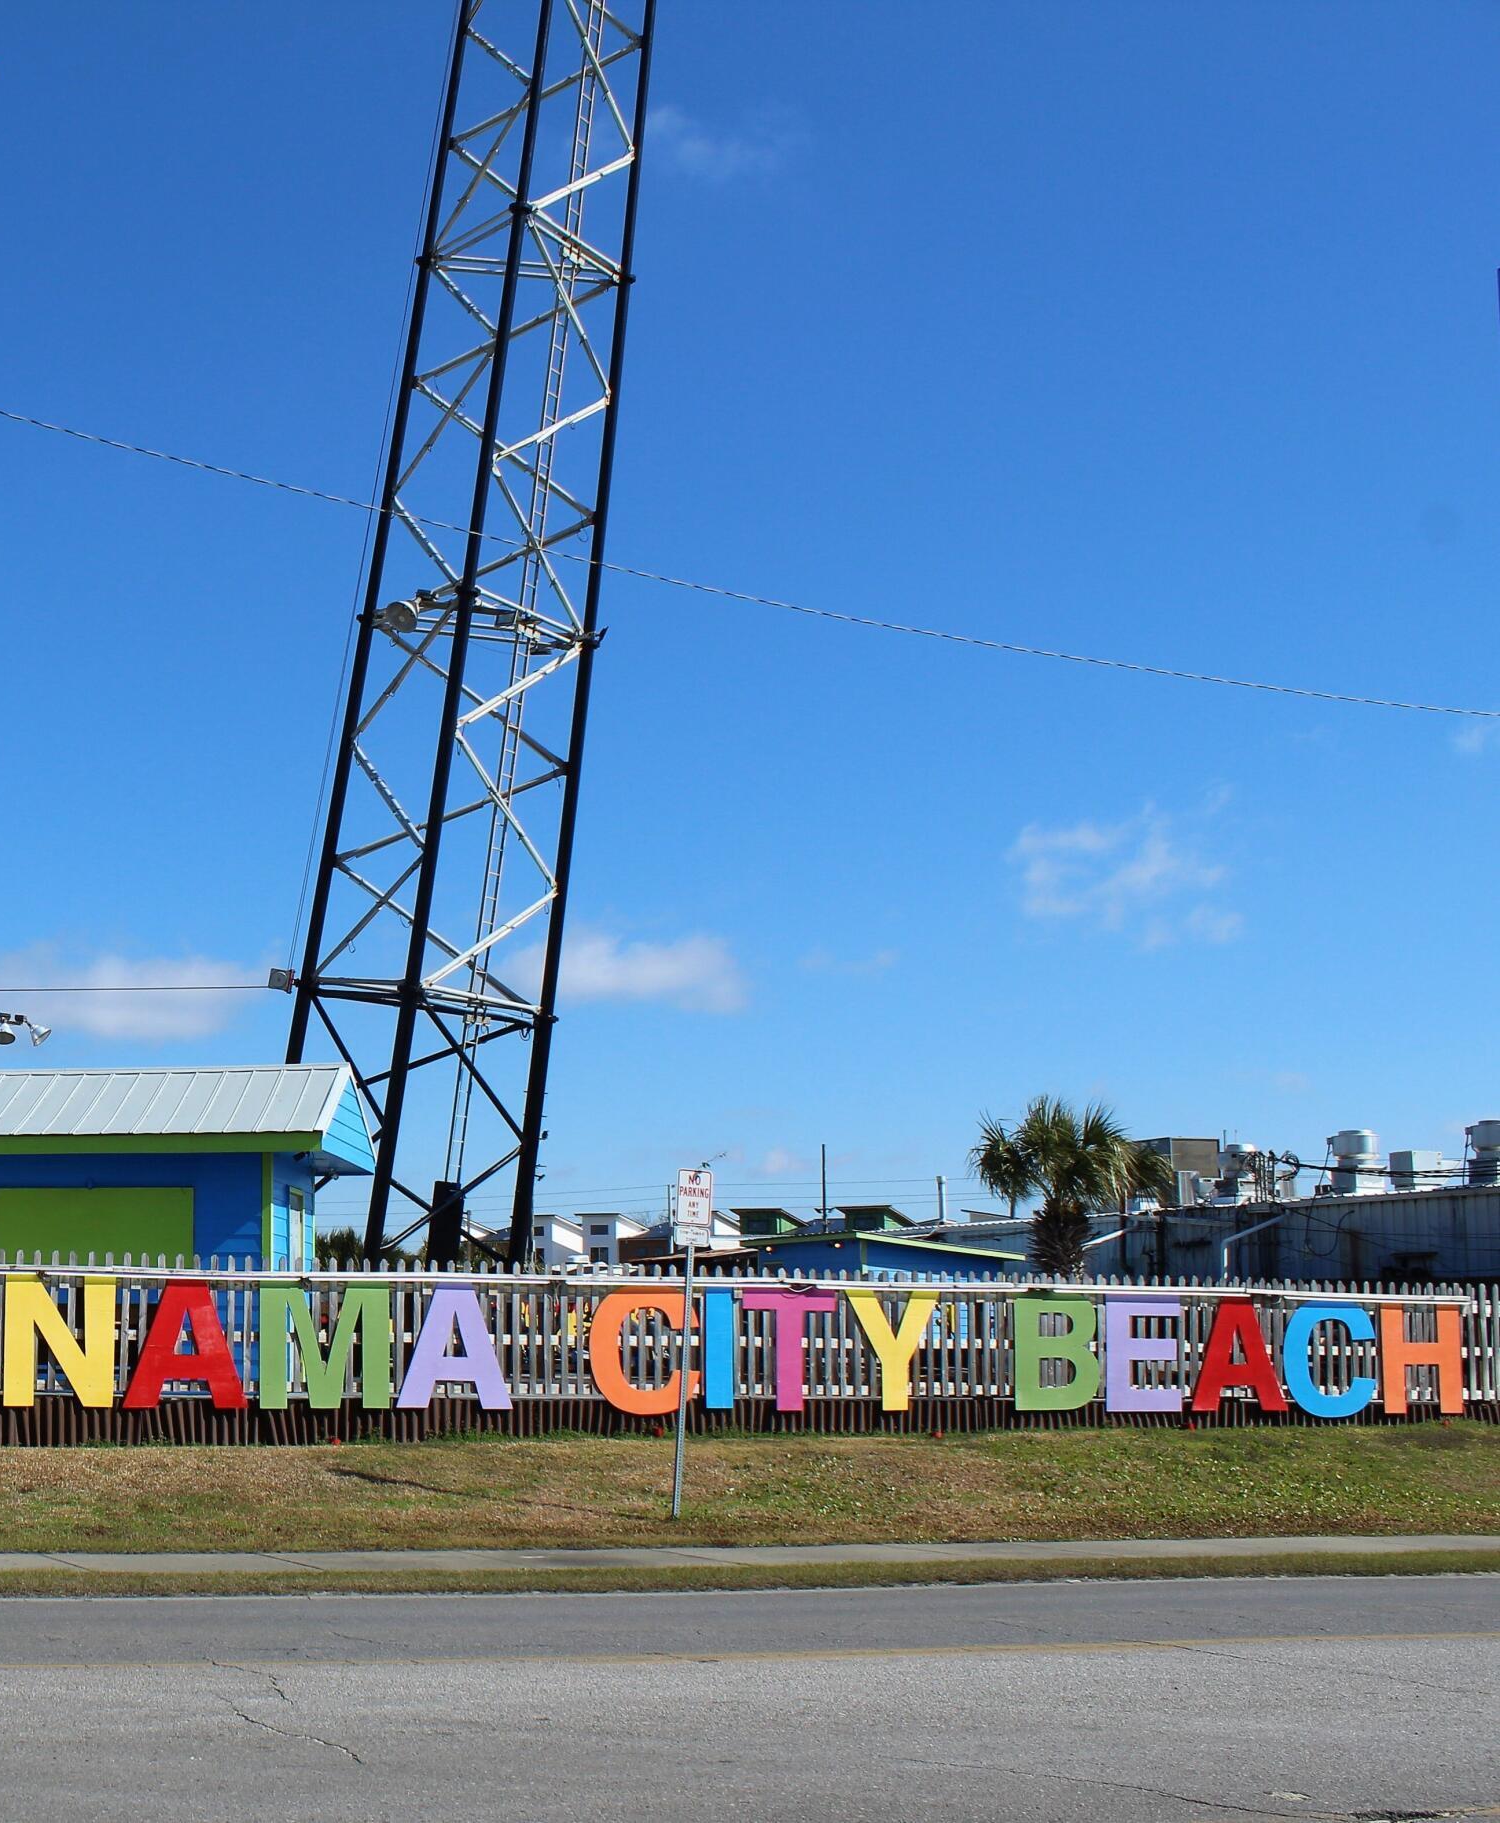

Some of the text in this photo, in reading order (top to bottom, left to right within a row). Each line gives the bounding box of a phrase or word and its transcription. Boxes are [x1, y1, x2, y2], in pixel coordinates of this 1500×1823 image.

[688, 1175, 701, 1185] NO
[679, 1186, 709, 1198] PARKING
[688, 1201, 699, 1209] ANY
[687, 1210, 699, 1218] TIME
[590, 1287, 939, 1416] CITY
[1014, 1290, 1464, 1418] BEACH
